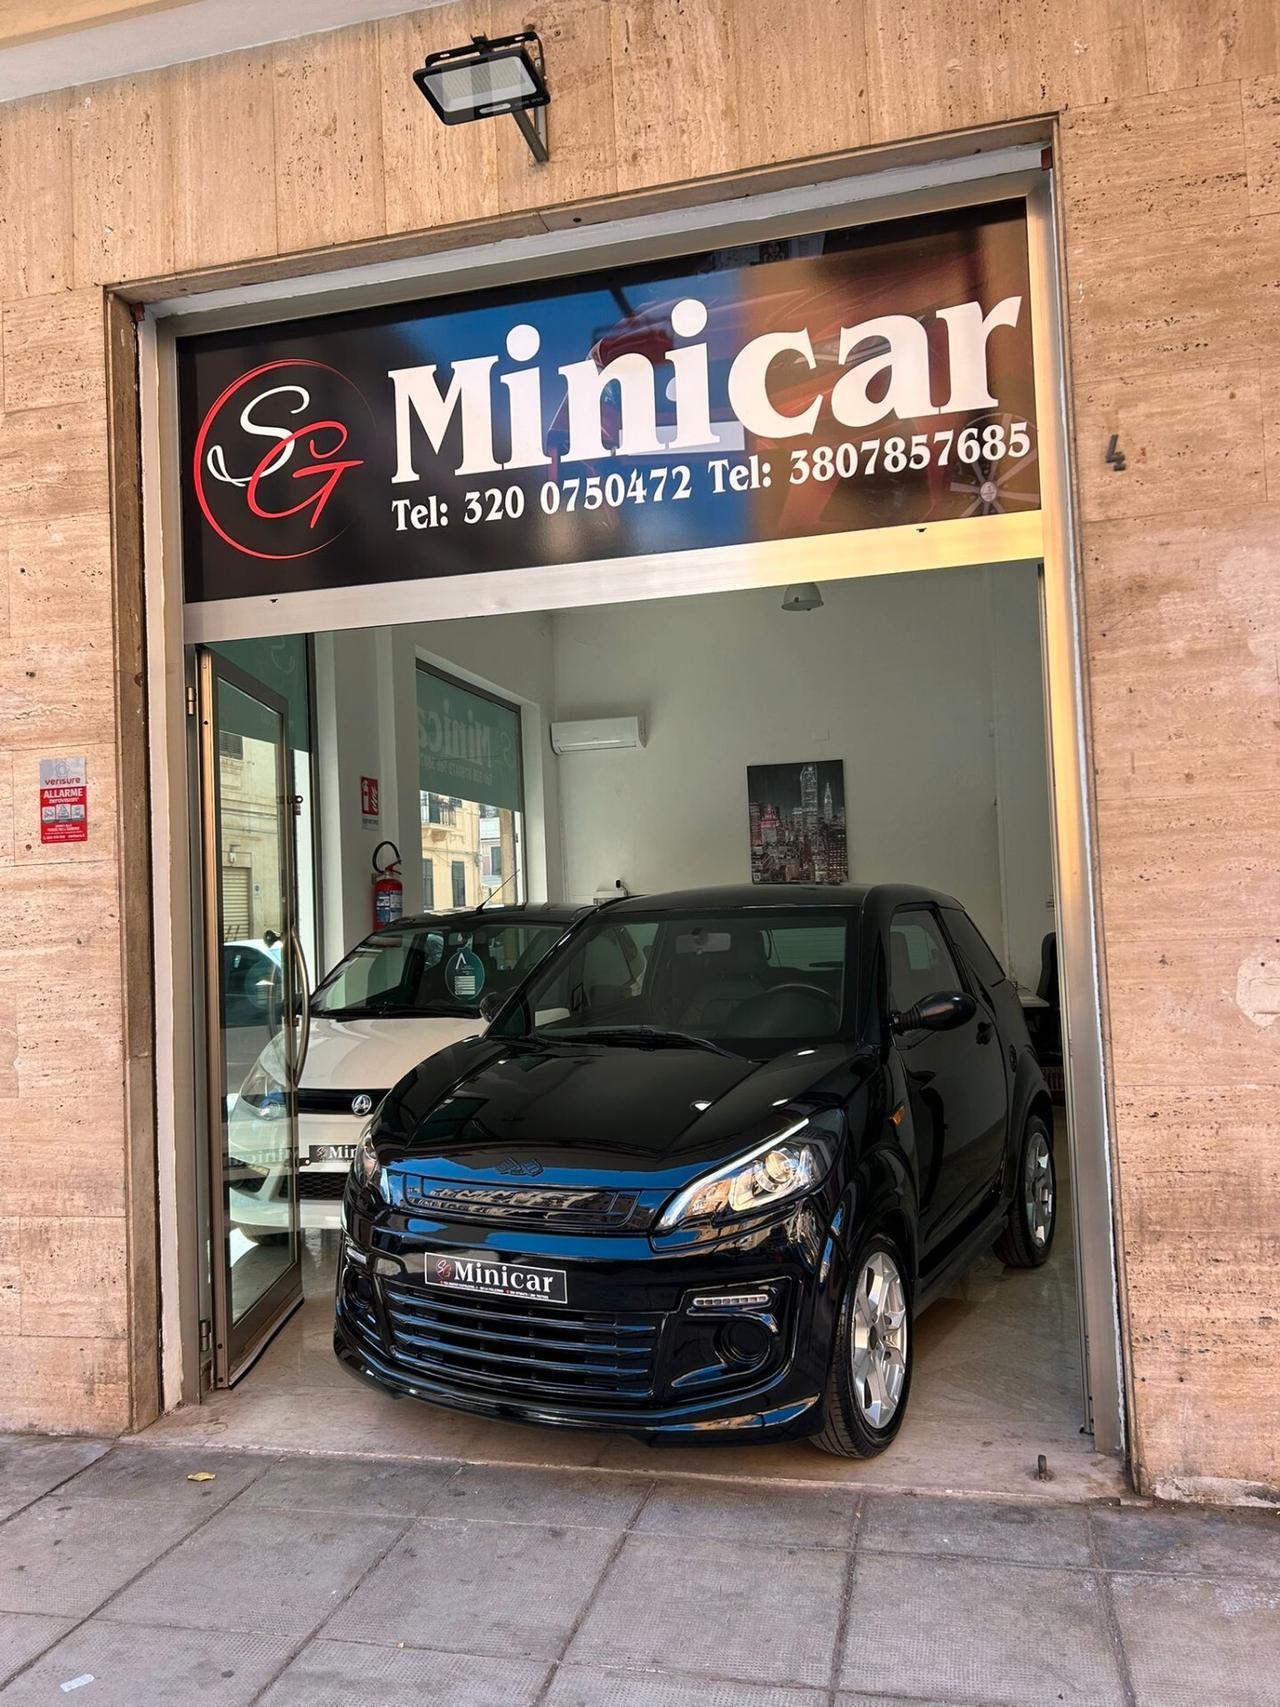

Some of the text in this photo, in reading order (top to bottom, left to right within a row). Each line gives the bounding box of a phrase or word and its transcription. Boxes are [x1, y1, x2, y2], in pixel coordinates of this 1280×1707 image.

[387, 296, 1022, 484] Minicar
[391, 421, 1031, 531] Tel: 320 0750472 Tel: 3807857685
[43, 788, 83, 799] ALLARME
[44, 776, 81, 786] verisure
[453, 1261, 554, 1293] Minicar
